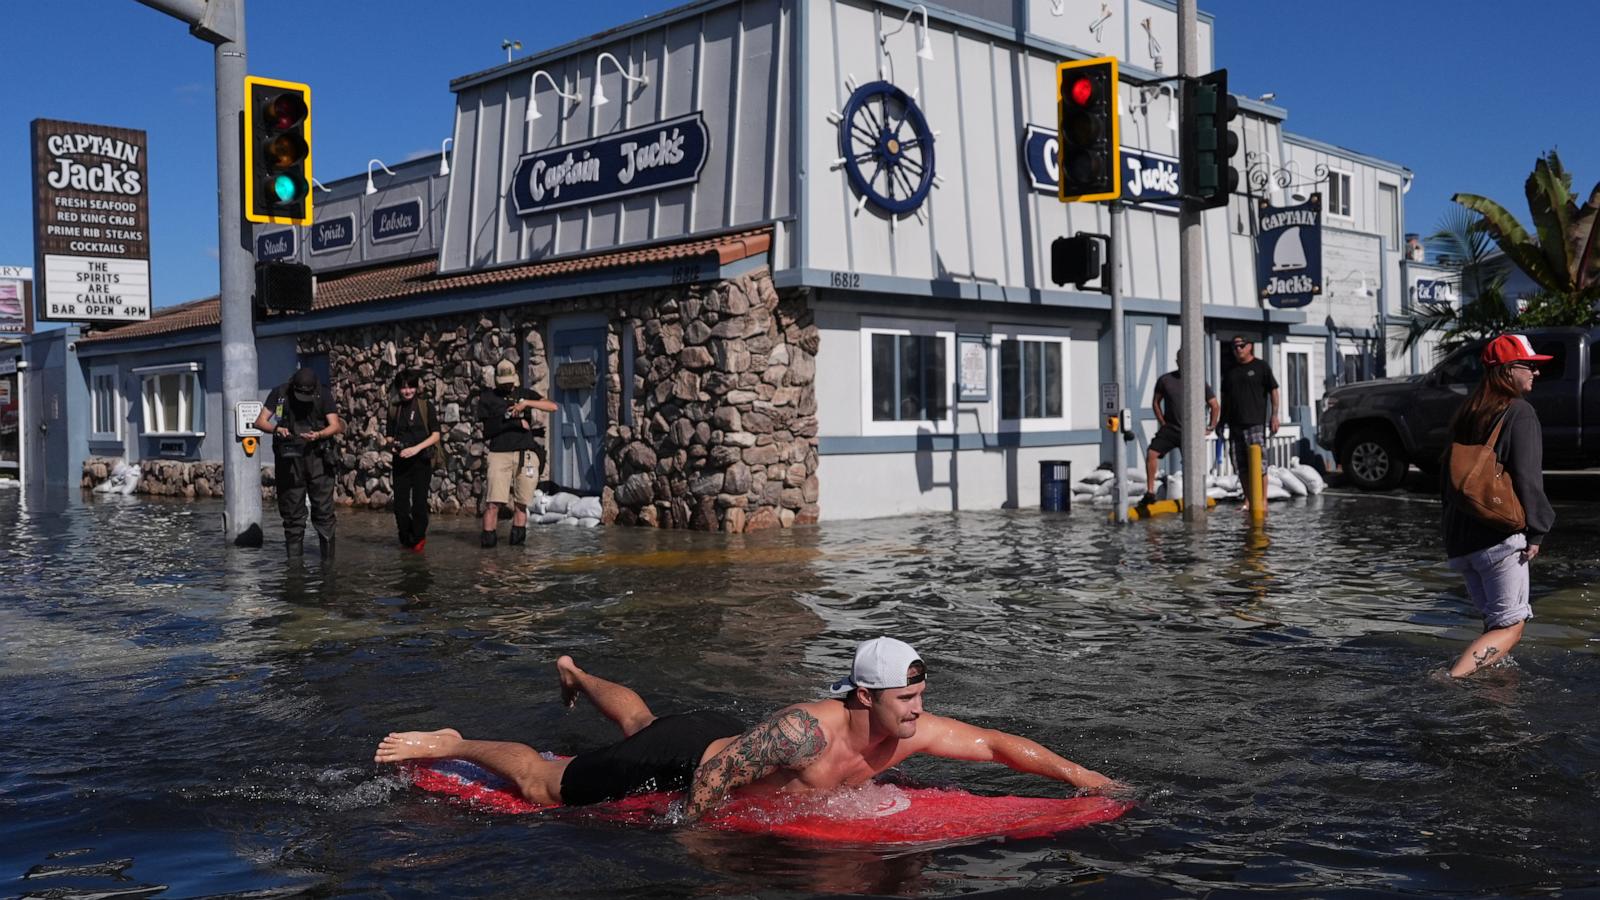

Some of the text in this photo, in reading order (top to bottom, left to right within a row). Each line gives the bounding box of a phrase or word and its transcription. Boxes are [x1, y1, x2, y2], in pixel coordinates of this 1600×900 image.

[48, 134, 139, 164] CAPTAIN
[529, 128, 685, 201] Captain Jack's
[47, 158, 141, 195] Jack's
[1127, 157, 1179, 196] Jack's
[55, 197, 136, 212] FRESH SEAFOOD
[57, 212, 135, 226] RED KING CRAB
[379, 214, 413, 233] Lobster
[1261, 210, 1317, 231] CAPTAIN
[48, 225, 143, 241] PRIME RIB STEAKS
[318, 223, 345, 246] Spirits
[70, 241, 125, 254] COCKTAILS
[263, 236, 288, 256] Steaks
[0, 266, 23, 277] RY
[88, 261, 108, 272] THE
[76, 272, 120, 284] SPIRITS
[830, 271, 860, 288] 16812
[1267, 275, 1313, 295] Jack's
[88, 284, 110, 294] ARE
[76, 294, 122, 305] CALLING
[52, 304, 146, 316] BAR OPEN 4PM
